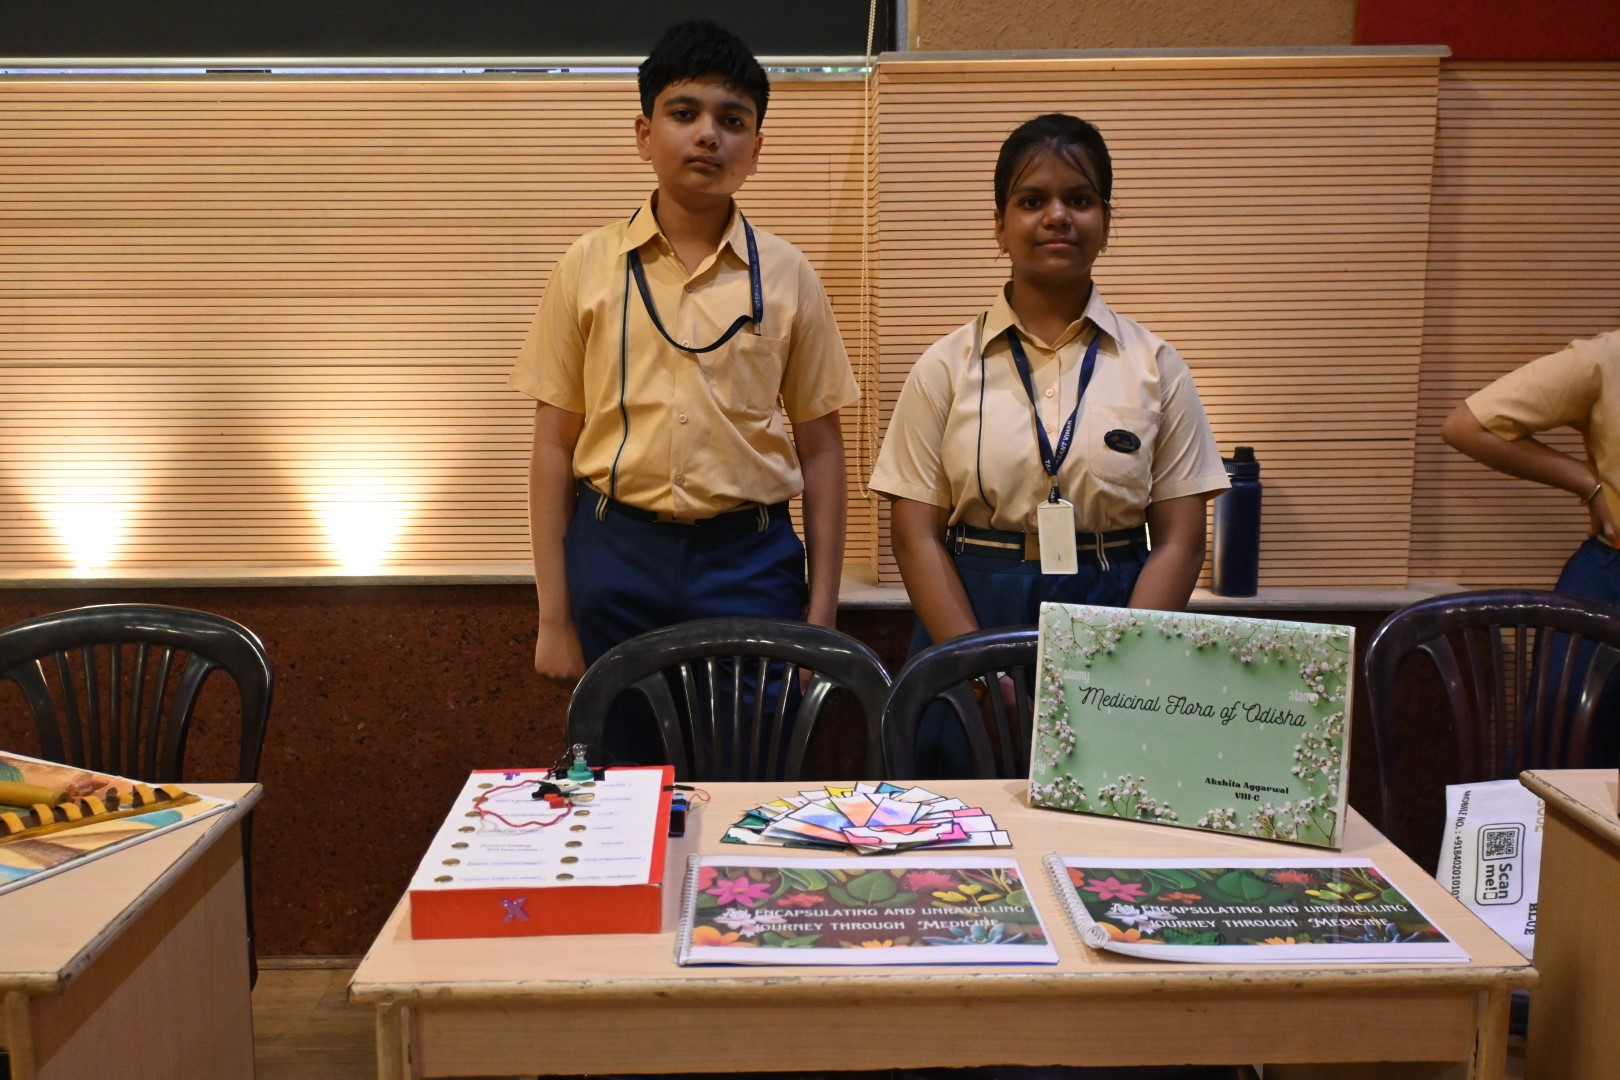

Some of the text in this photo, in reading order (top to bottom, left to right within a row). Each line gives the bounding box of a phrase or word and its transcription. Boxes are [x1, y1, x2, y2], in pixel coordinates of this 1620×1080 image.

[1079, 686, 1307, 727] Medicinal Flora of Odisha
[1205, 777, 1289, 795] Akshita Aggarwal
[1458, 790, 1471, 816] MOBILE
[1484, 864, 1496, 891] me!
[1499, 863, 1512, 899] Scan
[884, 908, 916, 916] AND
[921, 905, 1025, 915] UNRAVELLING
[1141, 905, 1263, 914] ENCAPSULATING
[1268, 906, 1299, 914] AND
[1304, 904, 1408, 913] UNRAVELLING
[830, 921, 906, 931] THROUGH
[1221, 919, 1299, 928] THROUGH
